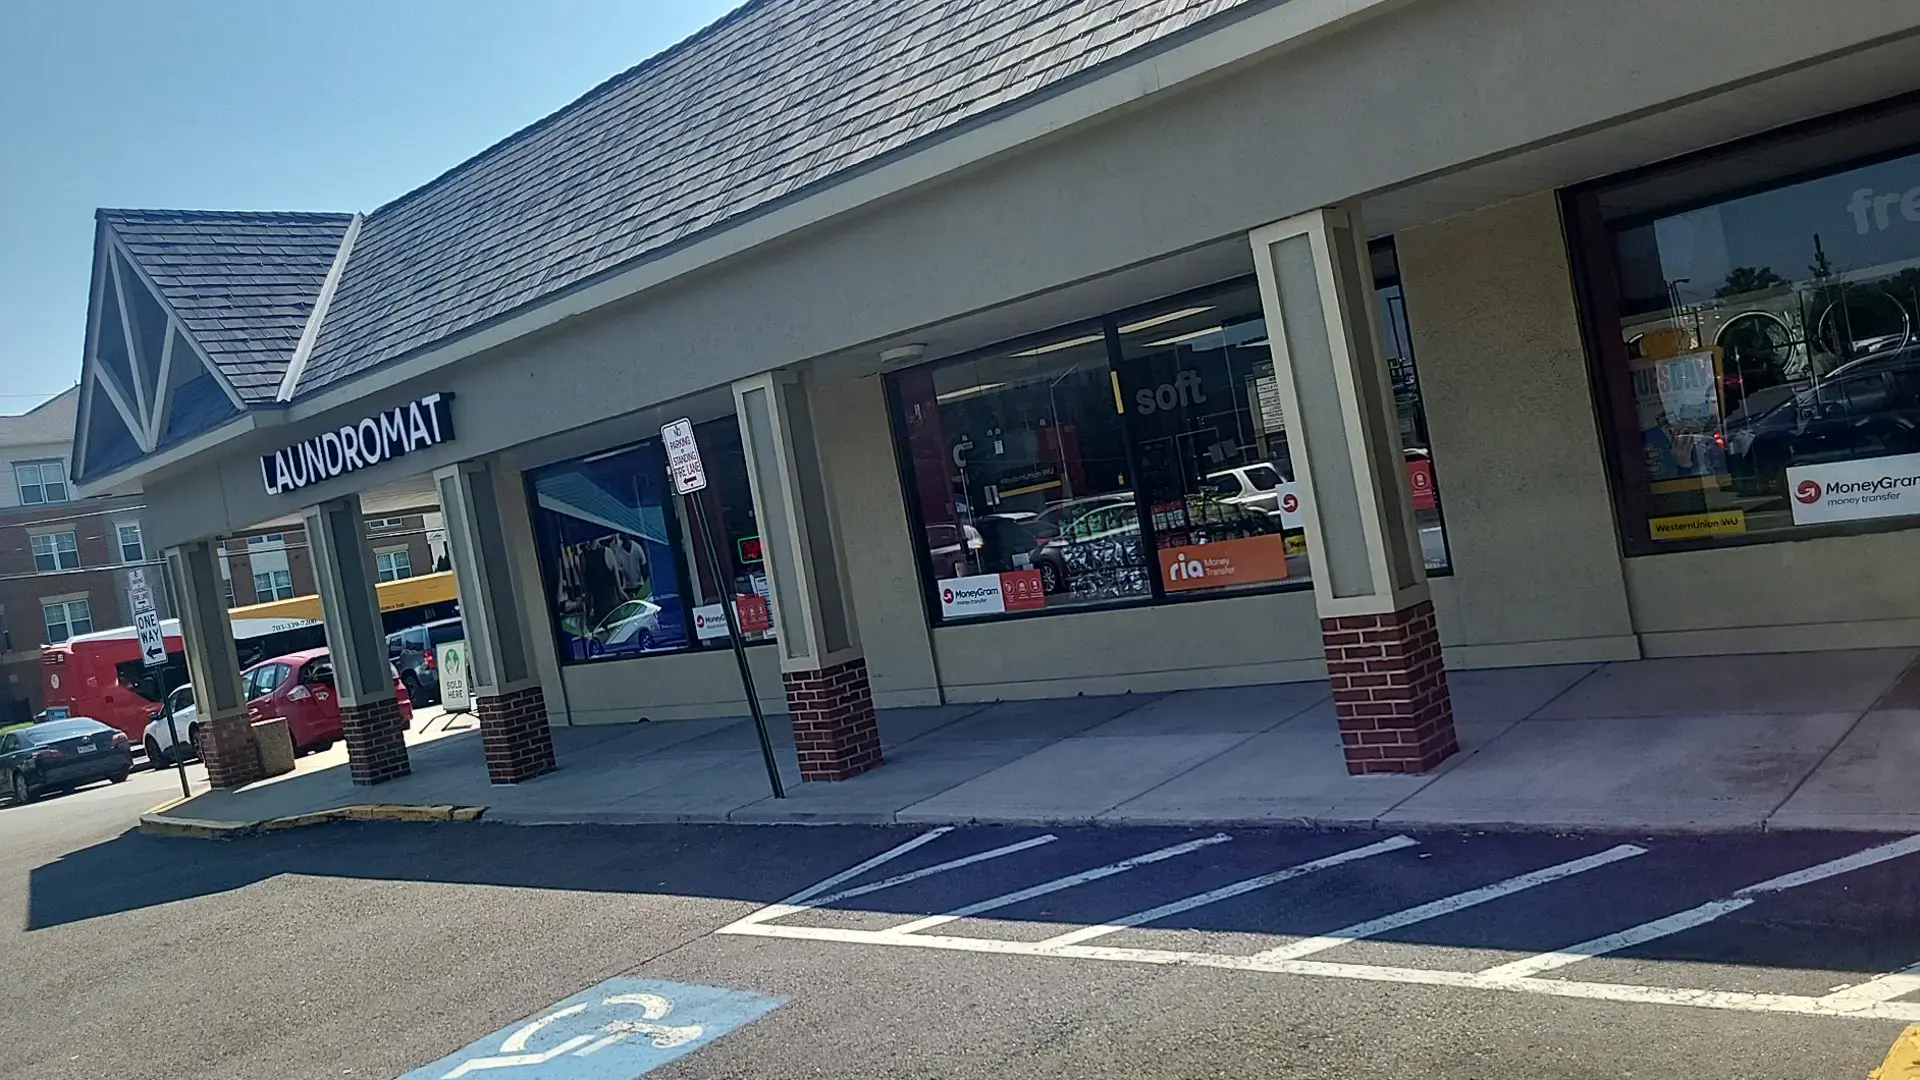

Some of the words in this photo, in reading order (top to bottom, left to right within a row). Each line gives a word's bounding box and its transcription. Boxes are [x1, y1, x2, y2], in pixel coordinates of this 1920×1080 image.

[1136, 369, 1207, 415] soft
[259, 392, 442, 496] LAUNDROMAT
[669, 436, 691, 450] PARKING
[673, 451, 697, 467] STANDING
[1828, 498, 1860, 506] money
[1861, 491, 1901, 503] transfer
[1656, 518, 1719, 533] WesternUnion
[1169, 553, 1205, 580] ria
[1204, 557, 1230, 568] Money
[1205, 566, 1236, 576] Transfer
[955, 587, 999, 600] MoneyGram
[138, 613, 157, 630] ONE
[705, 613, 727, 624] MoneyG
[140, 628, 160, 645] WAY
[445, 680, 463, 691] SOLD
[447, 688, 464, 699] HERE
